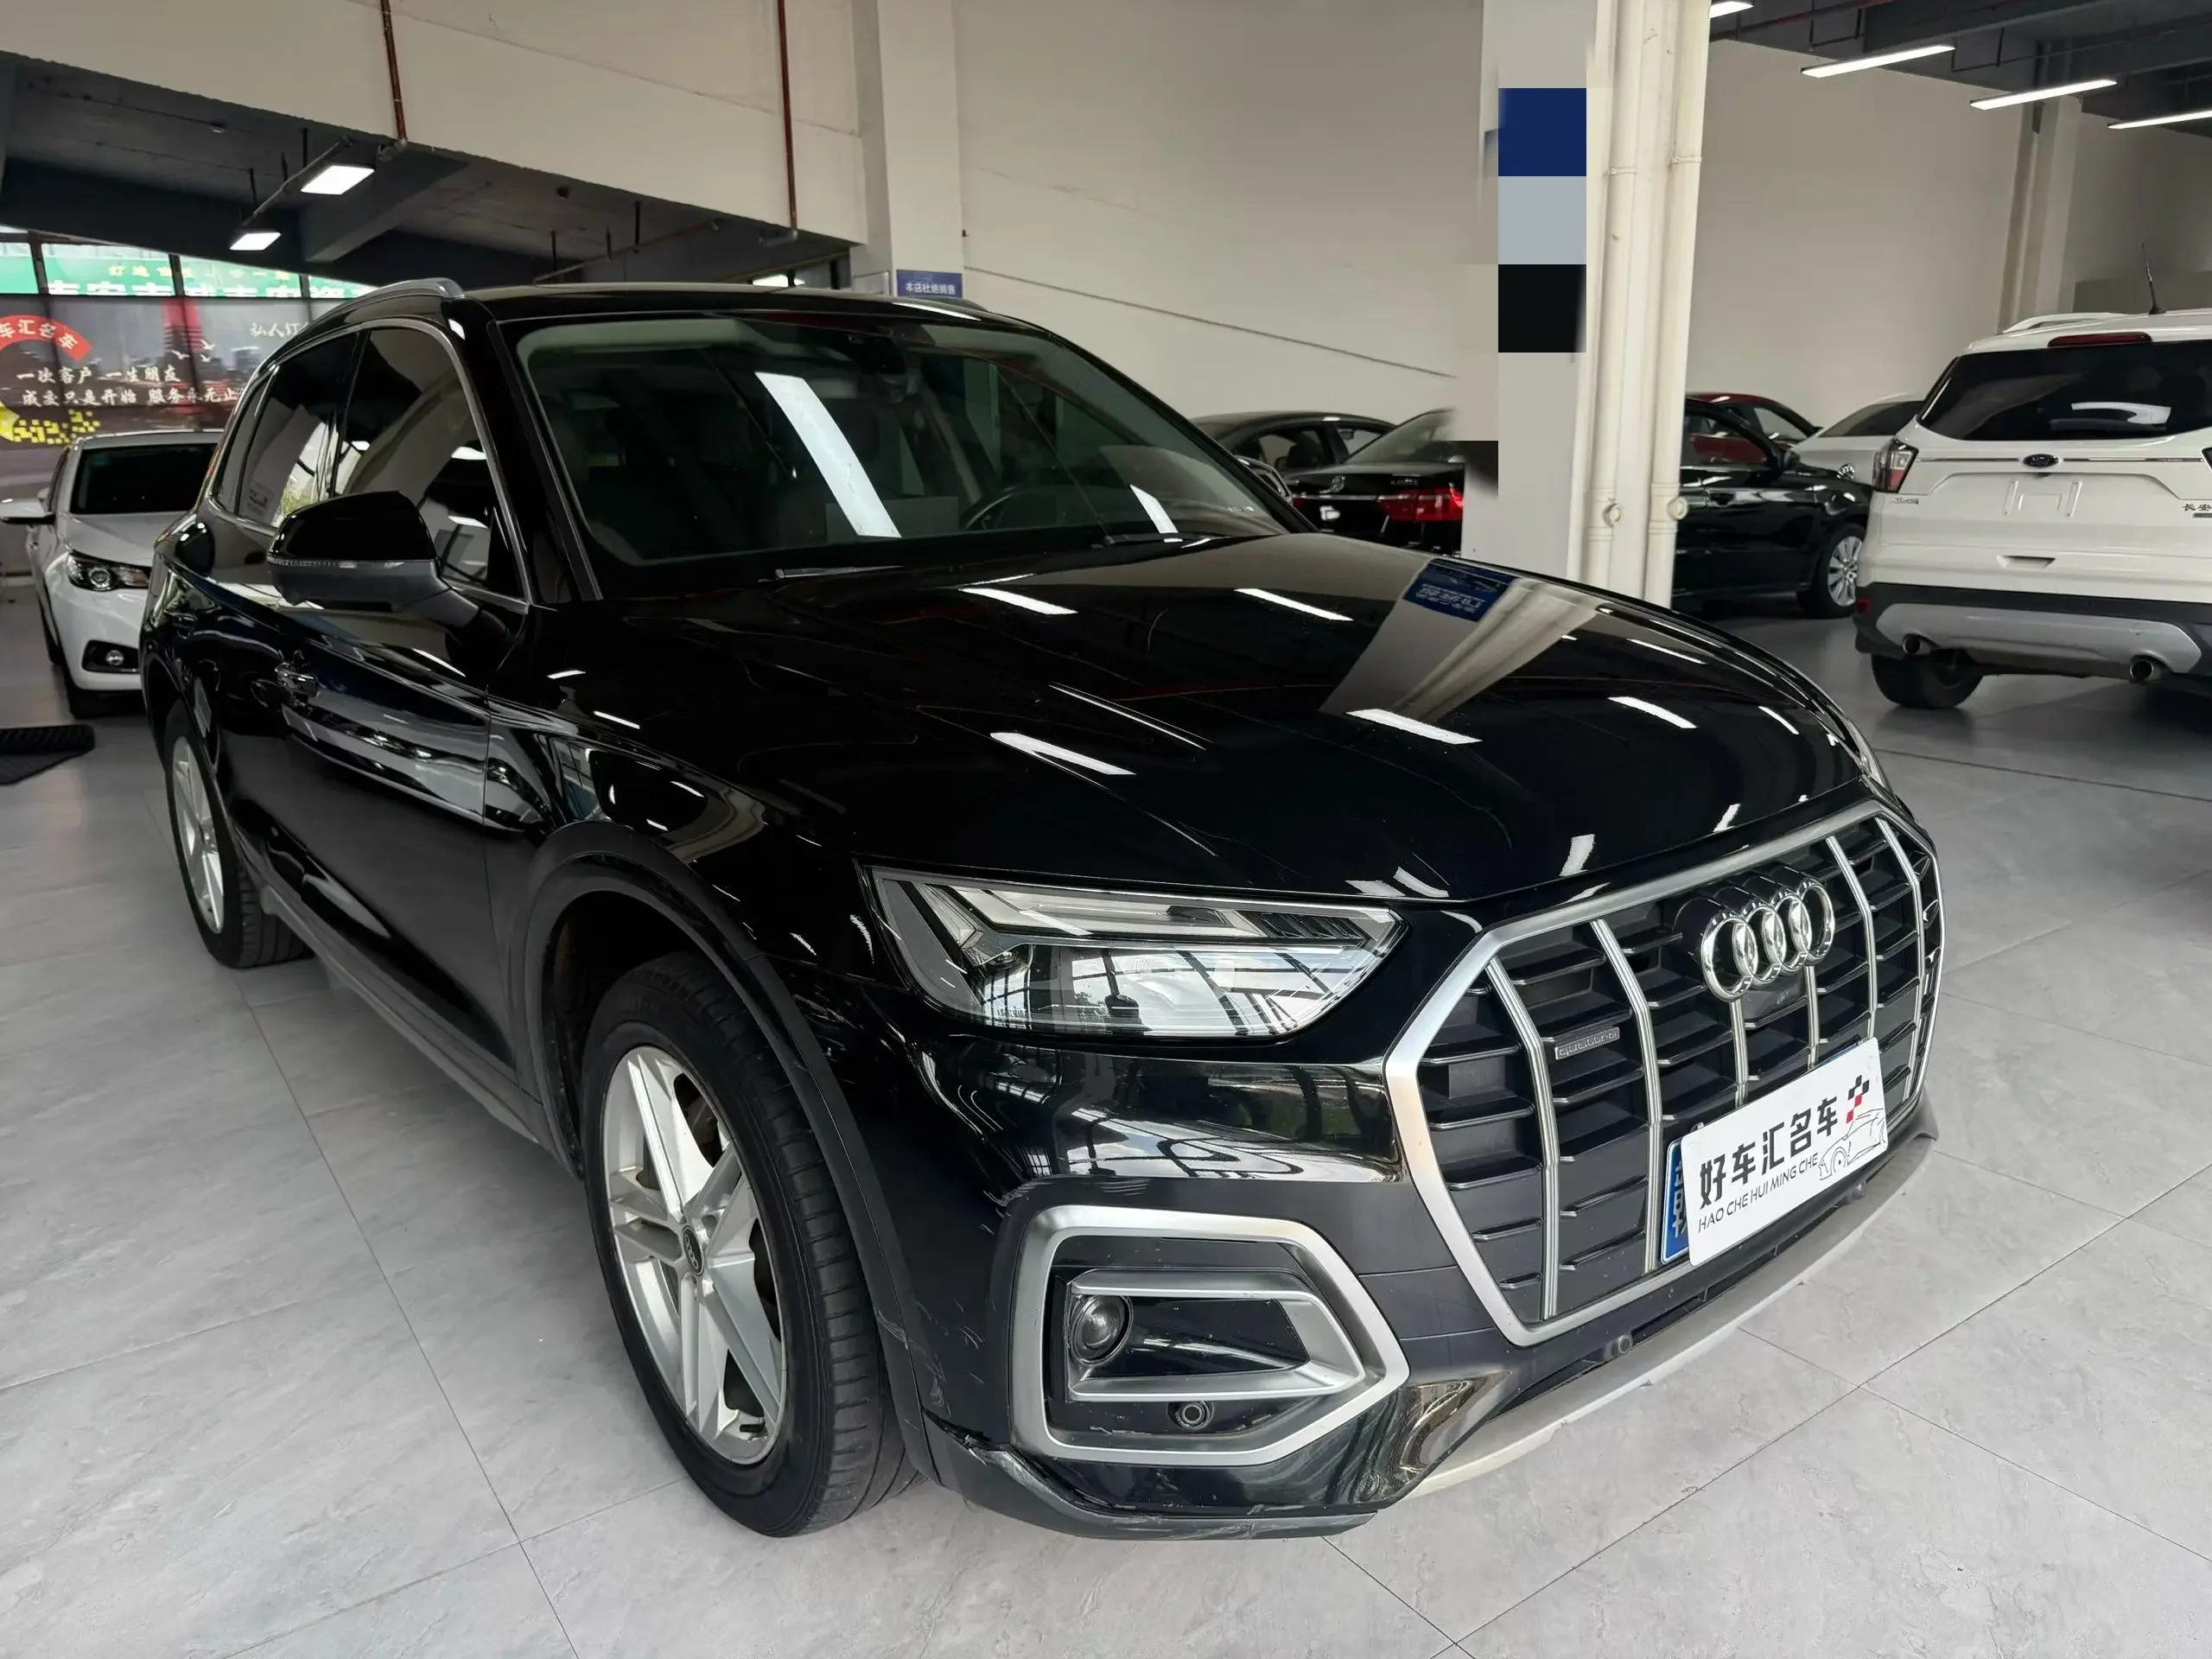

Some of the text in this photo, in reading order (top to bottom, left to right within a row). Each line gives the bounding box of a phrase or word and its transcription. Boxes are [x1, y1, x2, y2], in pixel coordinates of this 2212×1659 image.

[249, 321, 309, 338] 私人订
[16, 364, 181, 384] 一次客户 一生朋友
[22, 387, 244, 407] 成交只是开始 服务永无止
[1699, 1096, 1838, 1211] 好车汇名车
[1698, 1153, 1820, 1233] HAO CHE HUI MING CHE
